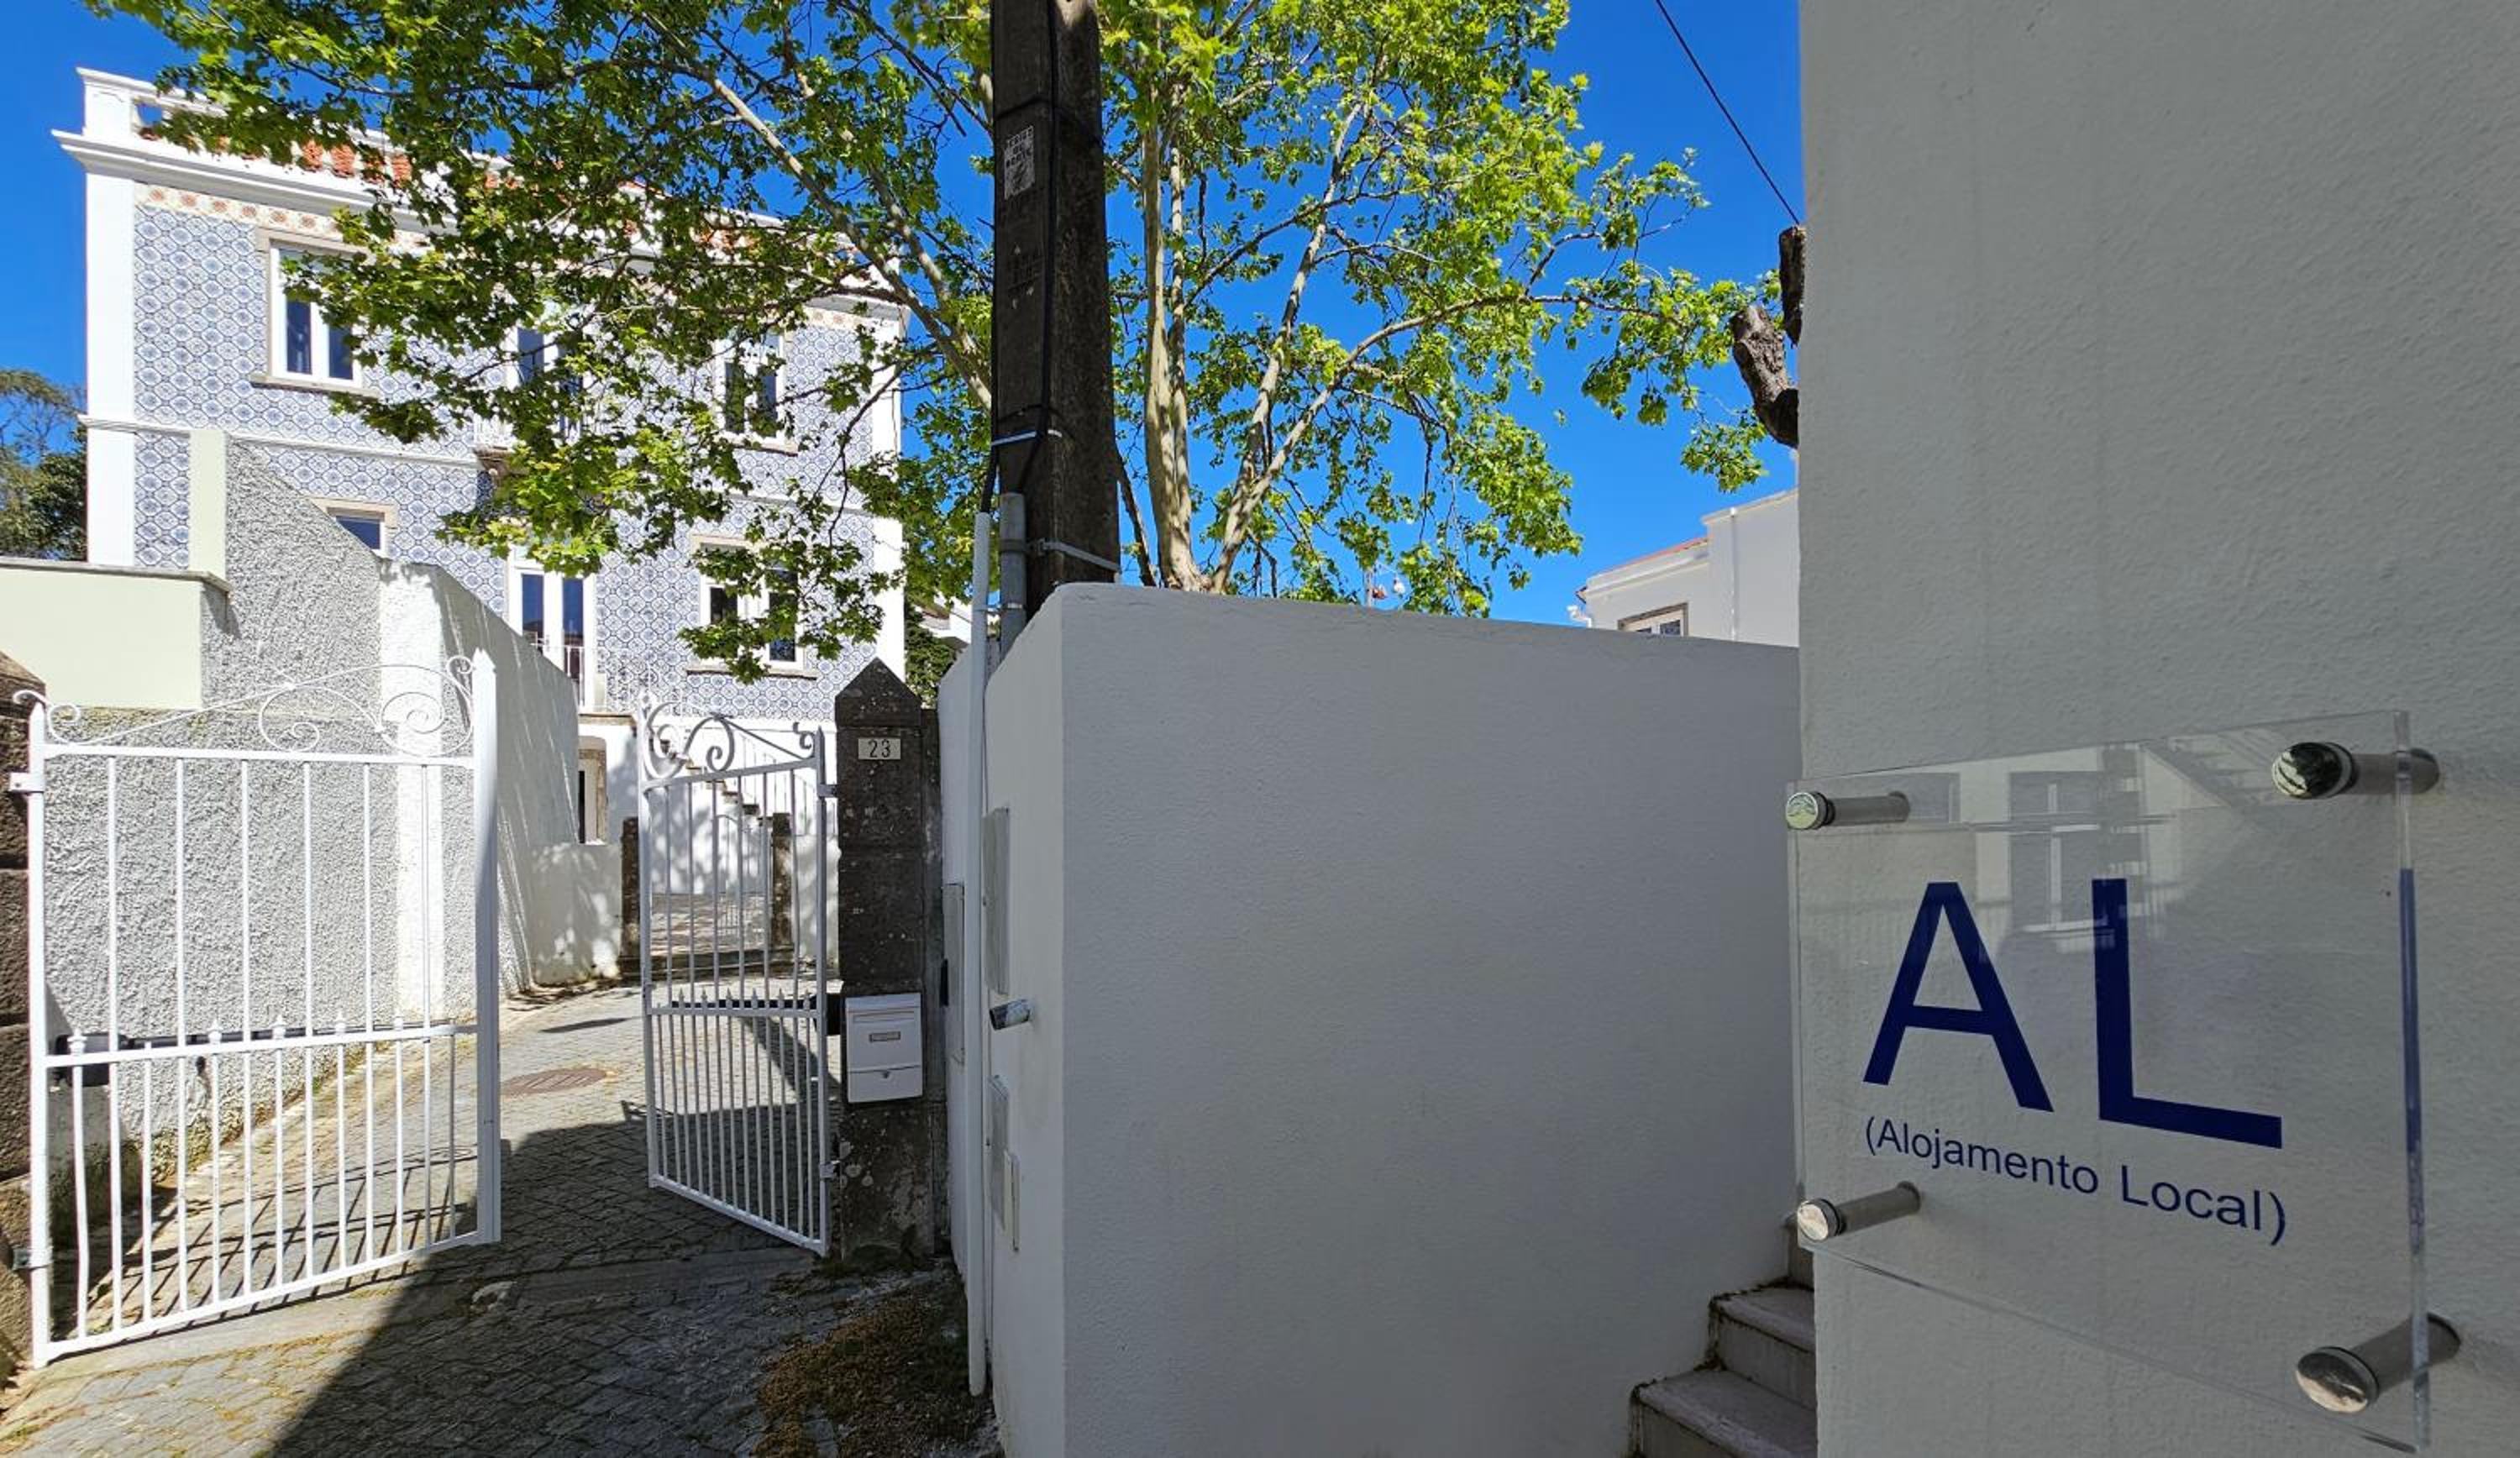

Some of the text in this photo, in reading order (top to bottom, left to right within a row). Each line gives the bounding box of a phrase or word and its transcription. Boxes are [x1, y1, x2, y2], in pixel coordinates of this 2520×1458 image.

[868, 739, 890, 758] 23
[1863, 878, 2282, 1149] AL
[1864, 1115, 2286, 1246] (Alojamento Local)
